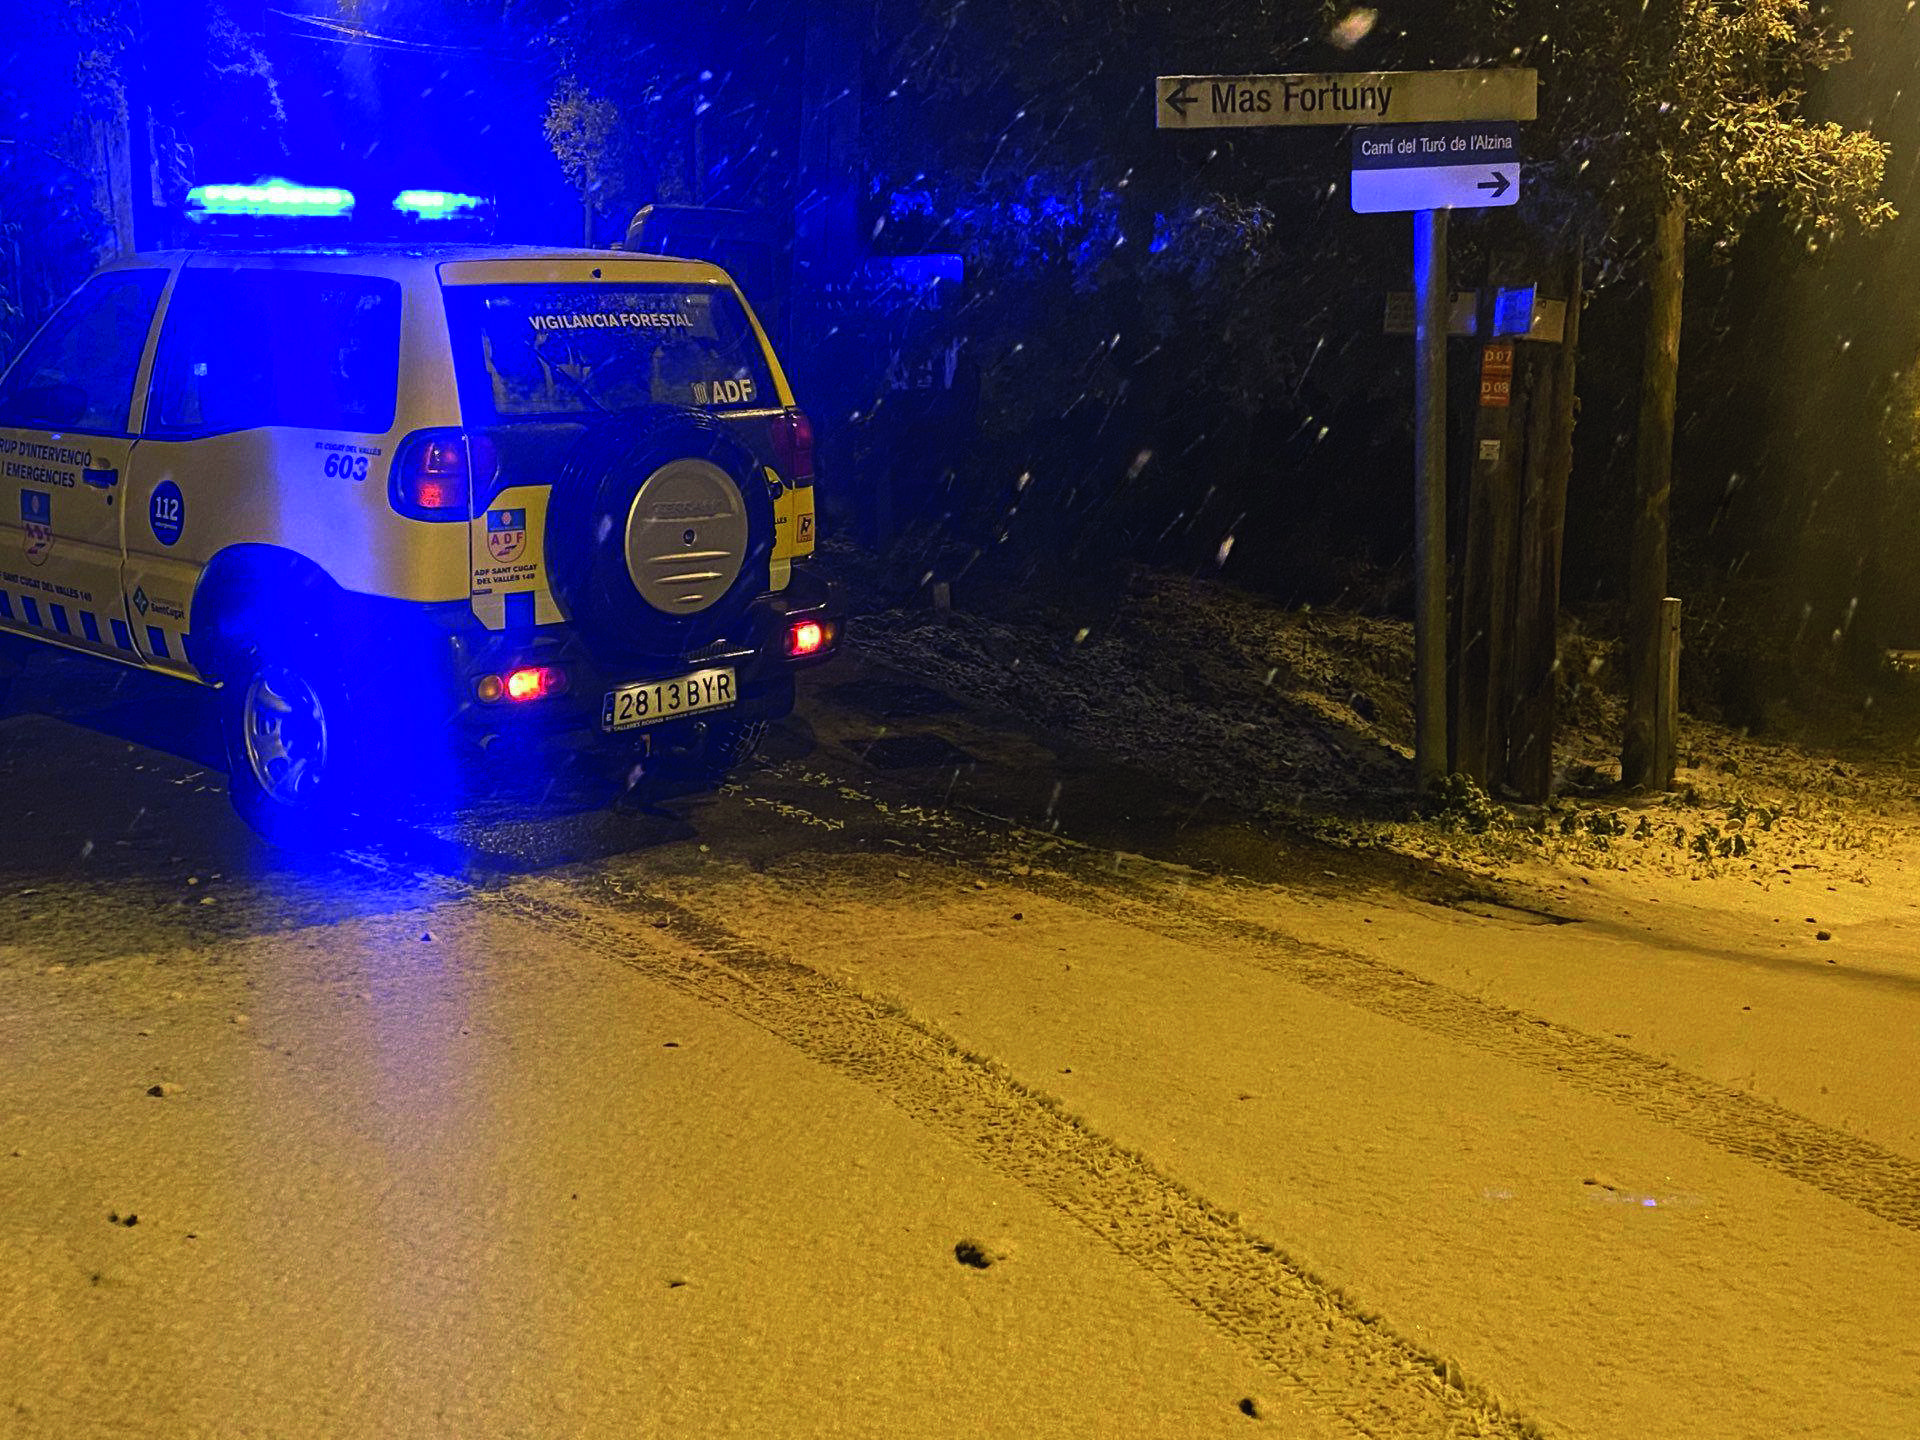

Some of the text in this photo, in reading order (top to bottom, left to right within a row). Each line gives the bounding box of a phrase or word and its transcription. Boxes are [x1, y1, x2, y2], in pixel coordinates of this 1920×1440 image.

[1211, 81, 1393, 116] Mas Fortuny
[1361, 134, 1512, 156] Camí del Turó de l'Alzina
[528, 311, 693, 330] VIGILÀNCIA FORESTAL
[713, 379, 752, 404] ADF
[1, 460, 5, 475] I
[324, 452, 369, 481] 603
[155, 496, 179, 521] 112
[491, 531, 524, 546] ADF
[474, 564, 537, 576] ADF SANT CUGAT
[619, 683, 681, 720] 2813
[687, 673, 731, 706] BYR
